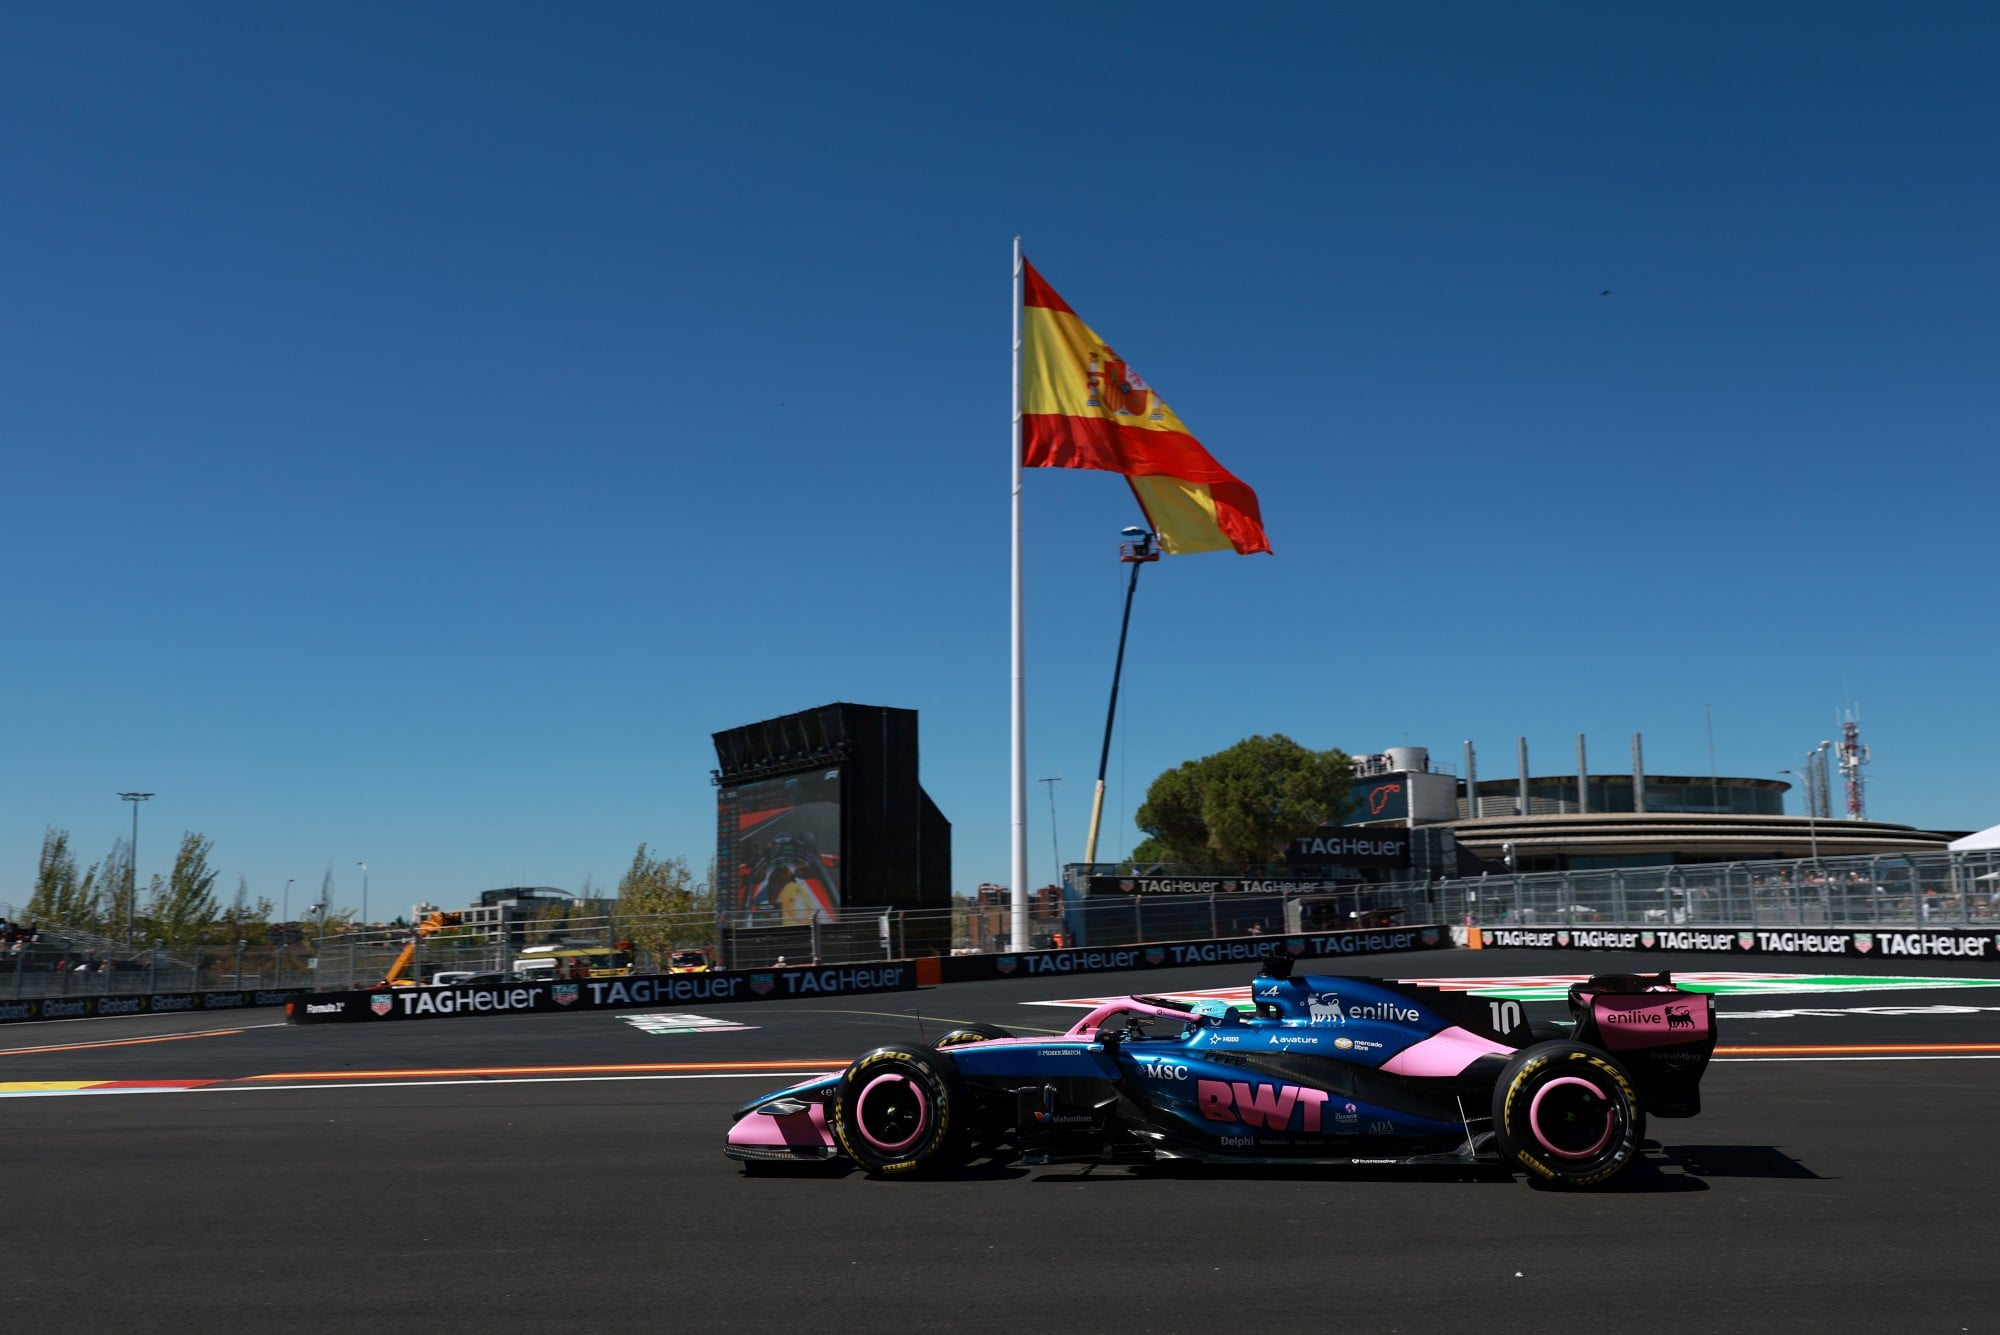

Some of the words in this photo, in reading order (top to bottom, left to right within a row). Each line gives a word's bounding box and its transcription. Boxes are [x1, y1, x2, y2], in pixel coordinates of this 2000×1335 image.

[1349, 1002, 1420, 1022] enilive
[1490, 1001, 1521, 1036] 10
[1607, 1010, 1662, 1025] enilive
[1280, 1036, 1318, 1044] avature
[1354, 1040, 1383, 1048] mercado
[860, 1052, 913, 1070] ZERO
[1147, 1063, 1188, 1081] MSC
[1197, 1079, 1330, 1133] BWT
[1052, 1114, 1093, 1123] Valvoline
[1220, 1135, 1254, 1148] Delphi
